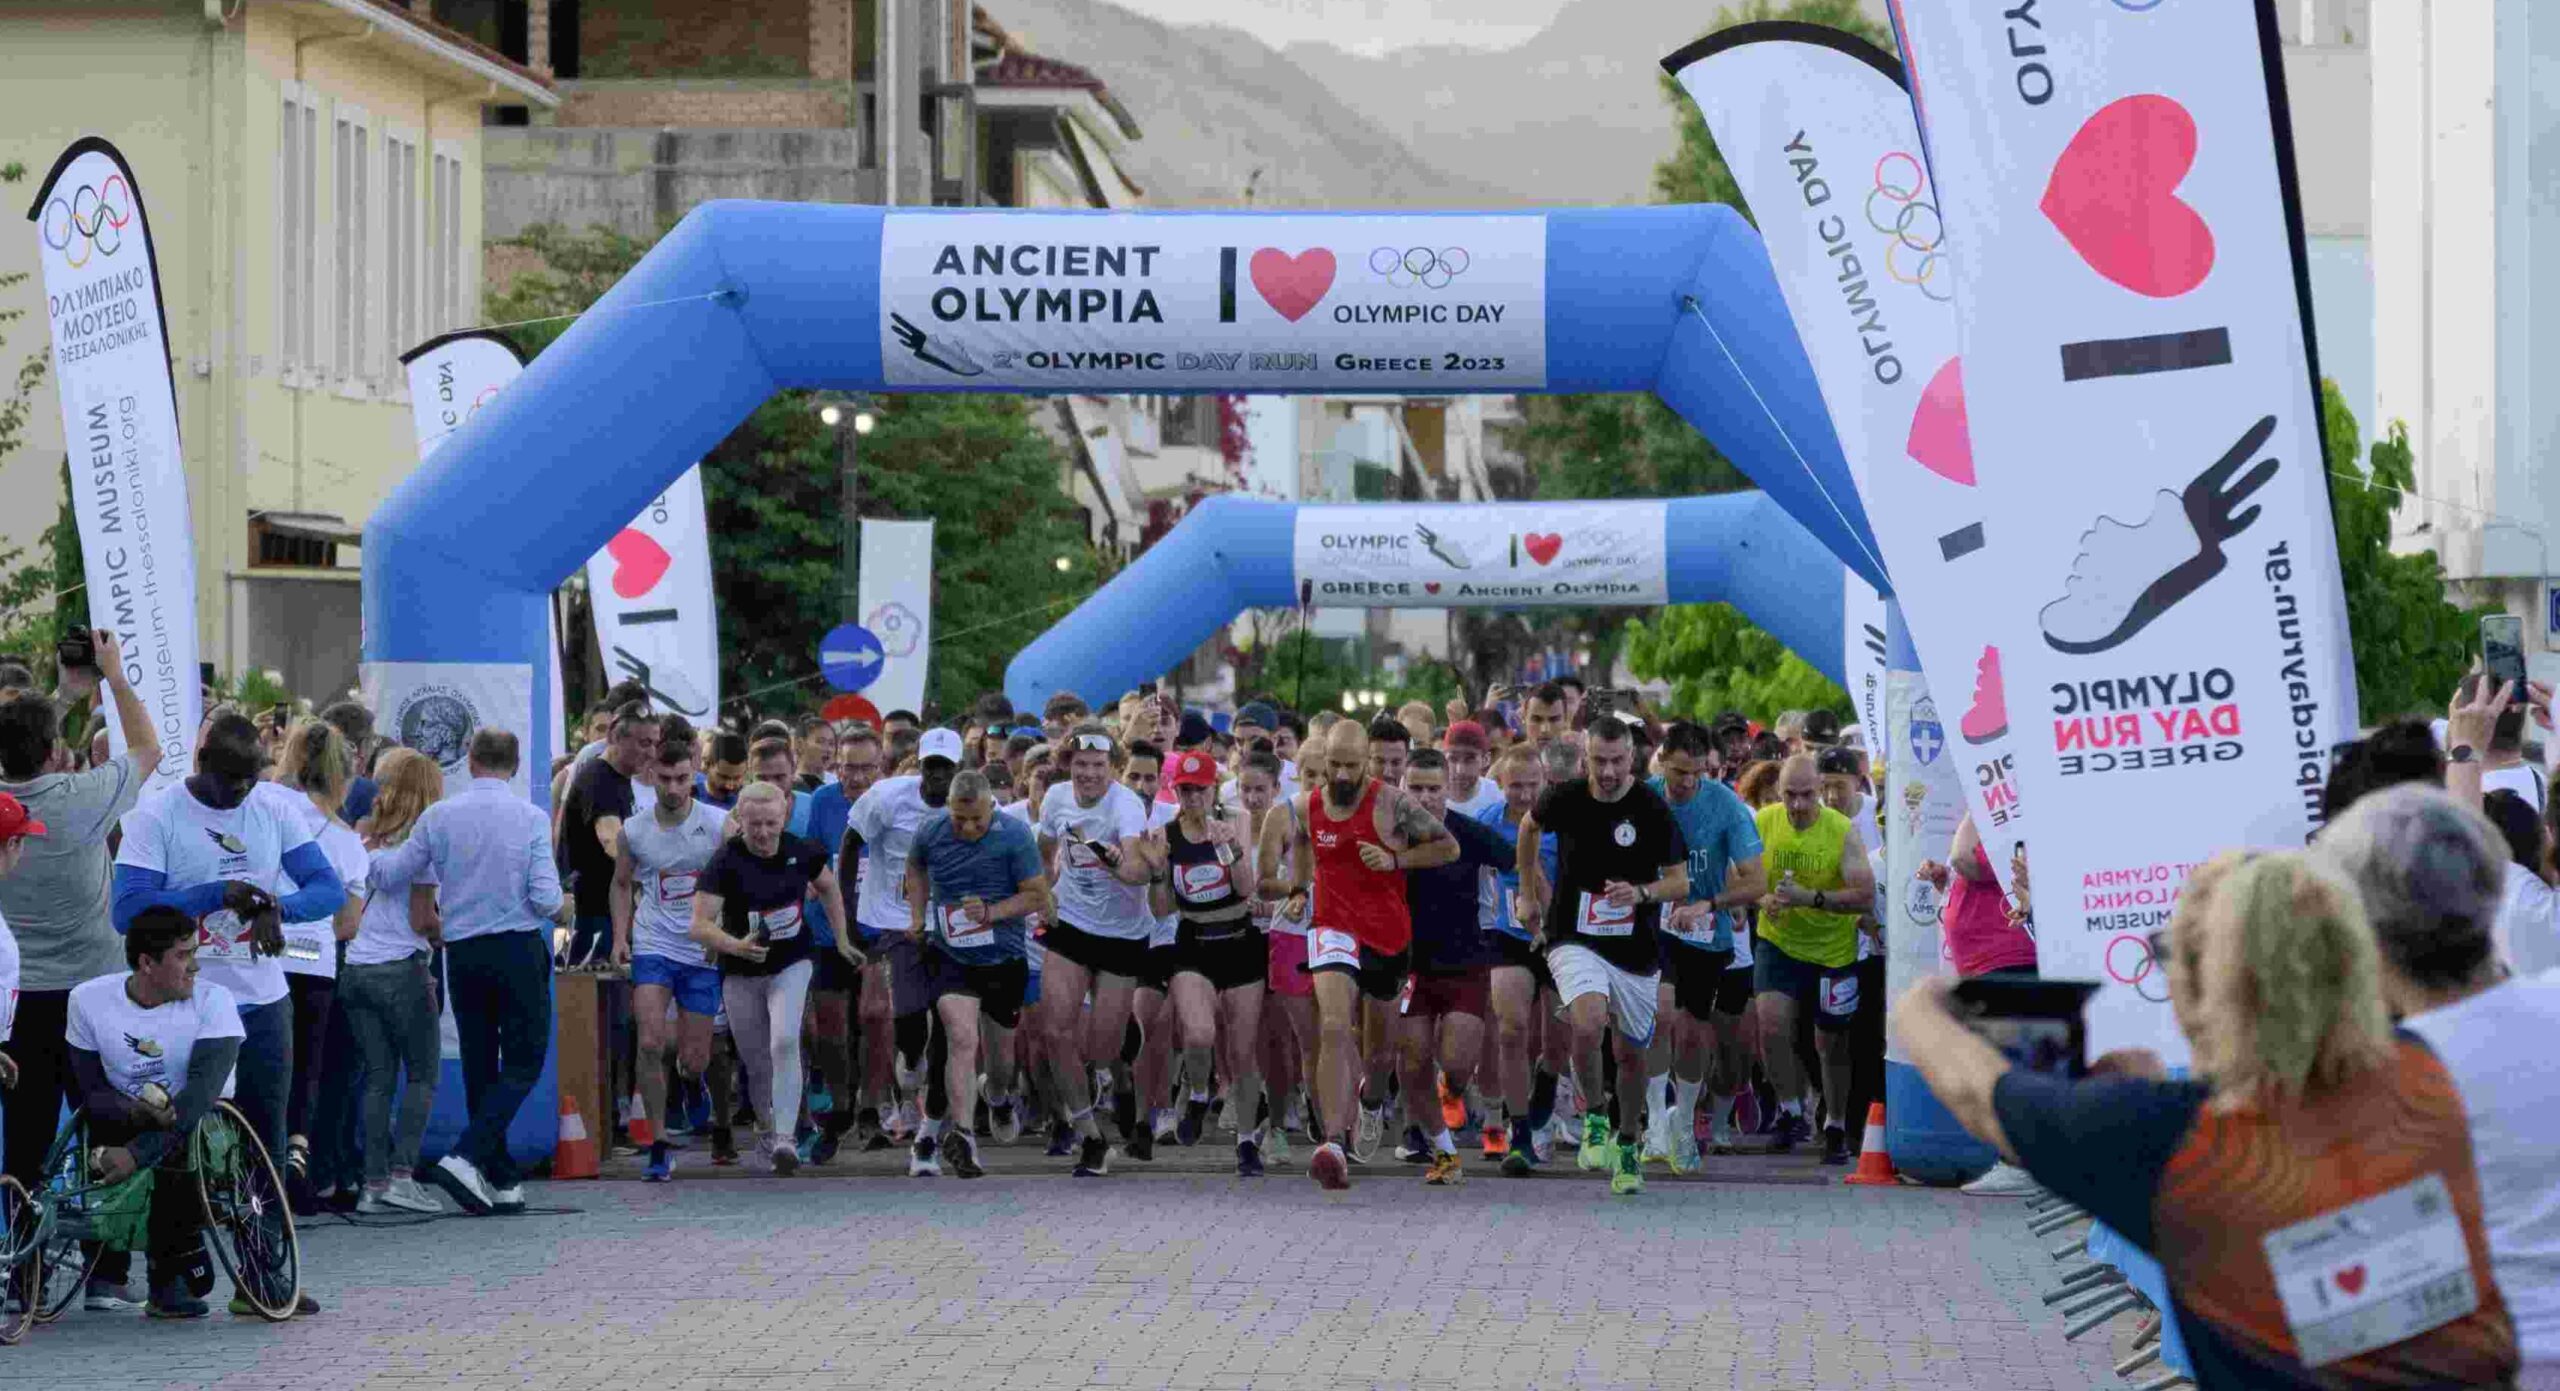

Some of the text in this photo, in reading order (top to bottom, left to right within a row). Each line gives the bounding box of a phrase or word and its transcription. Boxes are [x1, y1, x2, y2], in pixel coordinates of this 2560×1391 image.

[932, 245, 1160, 276] ANCIENT
[1219, 247, 1237, 323] I
[63, 298, 137, 342] ΜΟΥΣΕΙΟ
[931, 286, 1164, 324] OLYMPIA
[1334, 304, 1506, 323] OLYMPIC DAY
[1026, 351, 1165, 370] OLYMPIC
[1177, 352, 1242, 371] DAY
[1250, 352, 1318, 371] RUN
[1444, 353, 1506, 371] 2023
[87, 403, 143, 686] OLYMPIC MUSEUM
[1320, 534, 1410, 549] OLYMPIC
[1321, 582, 1411, 595] GREECE
